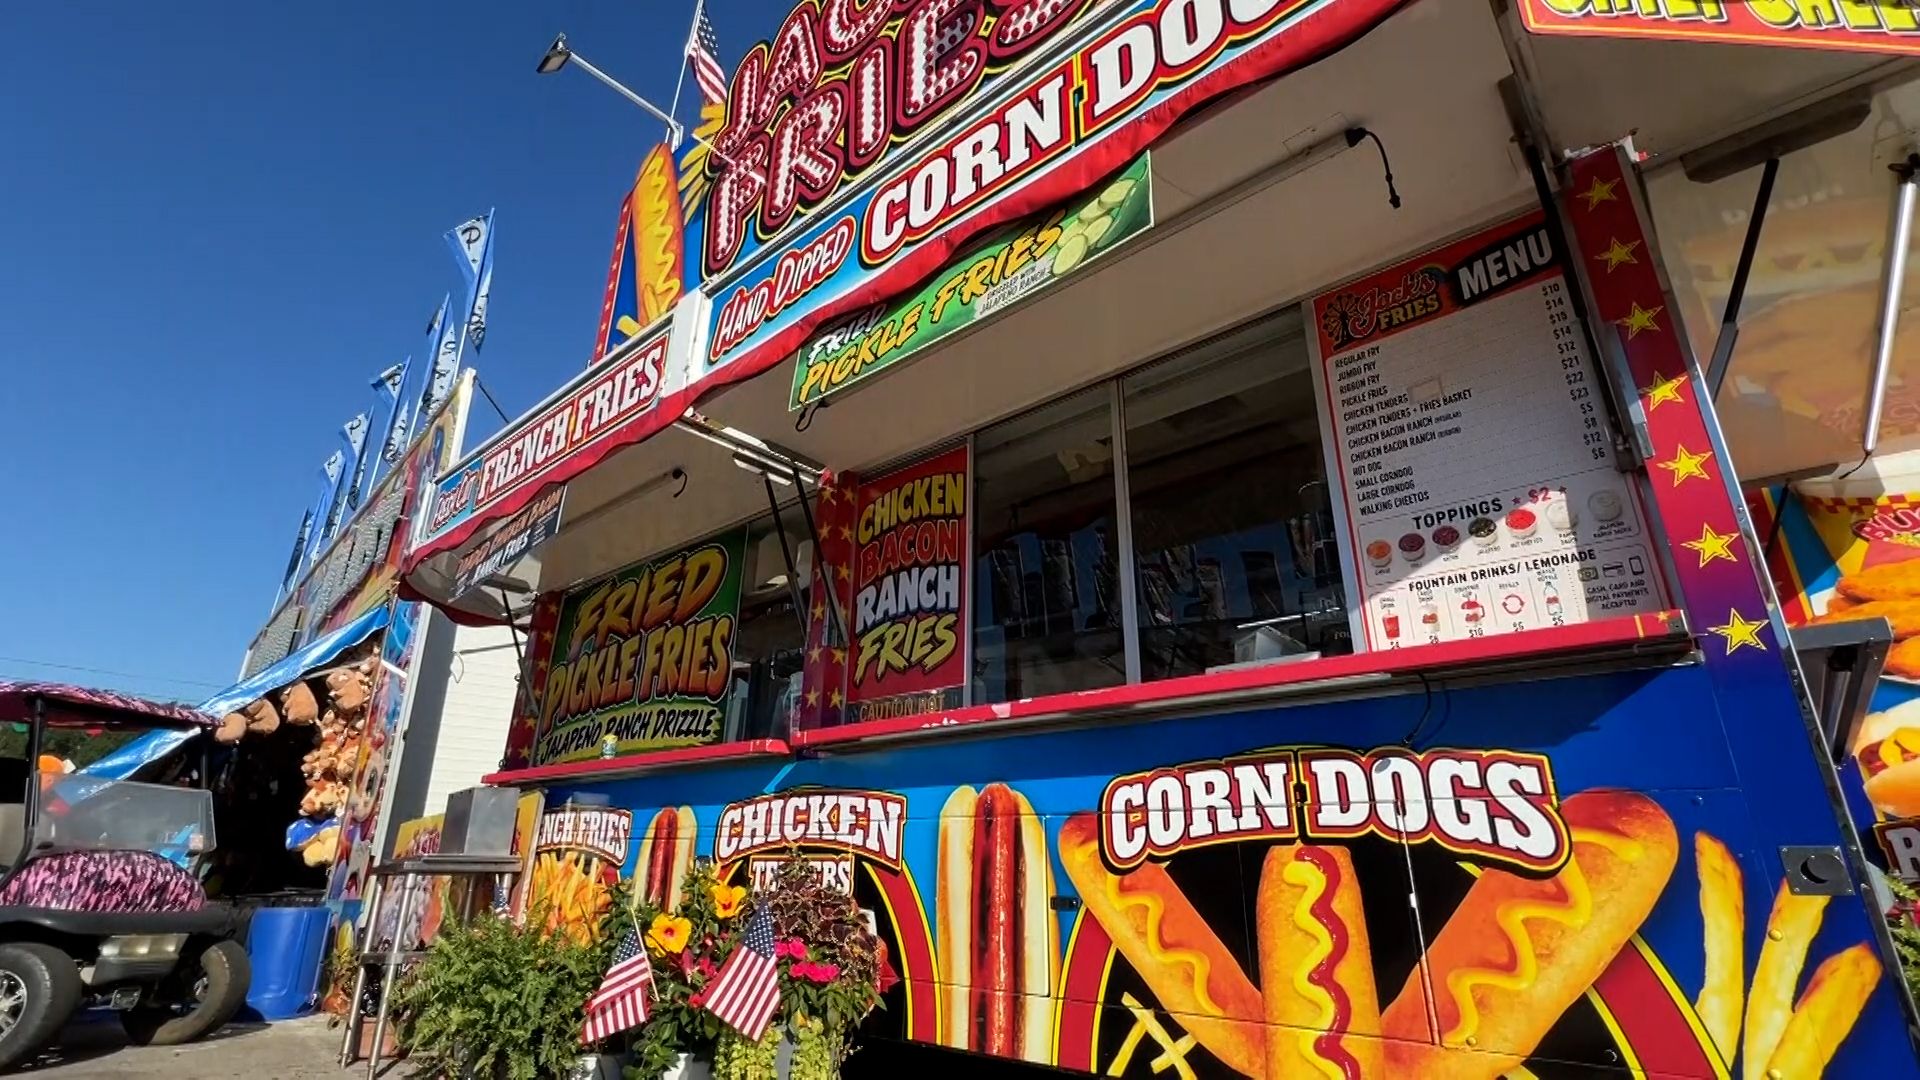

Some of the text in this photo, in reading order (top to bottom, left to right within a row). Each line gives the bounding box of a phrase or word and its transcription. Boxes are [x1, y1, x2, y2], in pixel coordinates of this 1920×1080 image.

[715, 0, 1284, 352] HAND DIPPED CORN DO
[1457, 228, 1554, 300] MENU
[799, 208, 1068, 404] PICKLE FRIES
[1542, 282, 1560, 297] $10
[1545, 296, 1564, 311] $14
[1379, 293, 1440, 331] FRIES
[806, 303, 888, 366] FRIED
[1553, 325, 1572, 341] $14
[1557, 340, 1576, 355] $12
[1335, 345, 1381, 369] REGULAR FRY
[1337, 361, 1377, 383] JUMBO FRY
[1561, 355, 1580, 371] $21
[1339, 373, 1381, 396] RIBBON FRY
[1565, 371, 1584, 386] $22
[1570, 386, 1590, 402] $23
[1341, 385, 1389, 409] PICKLE FRIES
[1343, 393, 1409, 422] CHICKEN TENDERS
[1345, 418, 1378, 436] CHICKEN
[1378, 407, 1412, 426] TENDERS
[1419, 398, 1442, 414] FRIES
[1442, 387, 1473, 407] BASKET
[1580, 401, 1594, 415] $5
[478, 404, 574, 500] FRENCH
[572, 345, 663, 442] FRIES
[1348, 431, 1380, 450] CHICKEN
[1380, 423, 1406, 440] BACON
[1406, 415, 1434, 432] RANCH
[1583, 431, 1602, 447] $12
[1350, 446, 1383, 464] CHICKEN
[1383, 437, 1409, 455] BACON
[1409, 431, 1437, 447] RANCH
[1352, 460, 1383, 477] HOT DOG
[1355, 465, 1414, 490] SMALL CORNDOG
[1357, 479, 1416, 504] LARGE CORNDOG
[1359, 489, 1431, 516] WALKING CHEETOS
[1411, 486, 1552, 530] TOPPINGS $2
[857, 472, 965, 546] CHICKEN
[860, 518, 960, 588] BACON
[1408, 573, 1467, 592] FOUNTAIN
[1525, 549, 1597, 572] LEMONADE
[568, 546, 727, 662] FRIED
[855, 564, 960, 636] RANCH
[853, 612, 959, 689] FRIES
[540, 615, 732, 741] PICKLE FRIES
[604, 710, 651, 742] RANCH
[650, 707, 718, 740] DRIZZLE
[859, 697, 913, 722] CAUTION
[1110, 758, 1557, 859] CORN DOGS
[576, 810, 629, 860] FRIES
[717, 794, 902, 860] CHICKEN
